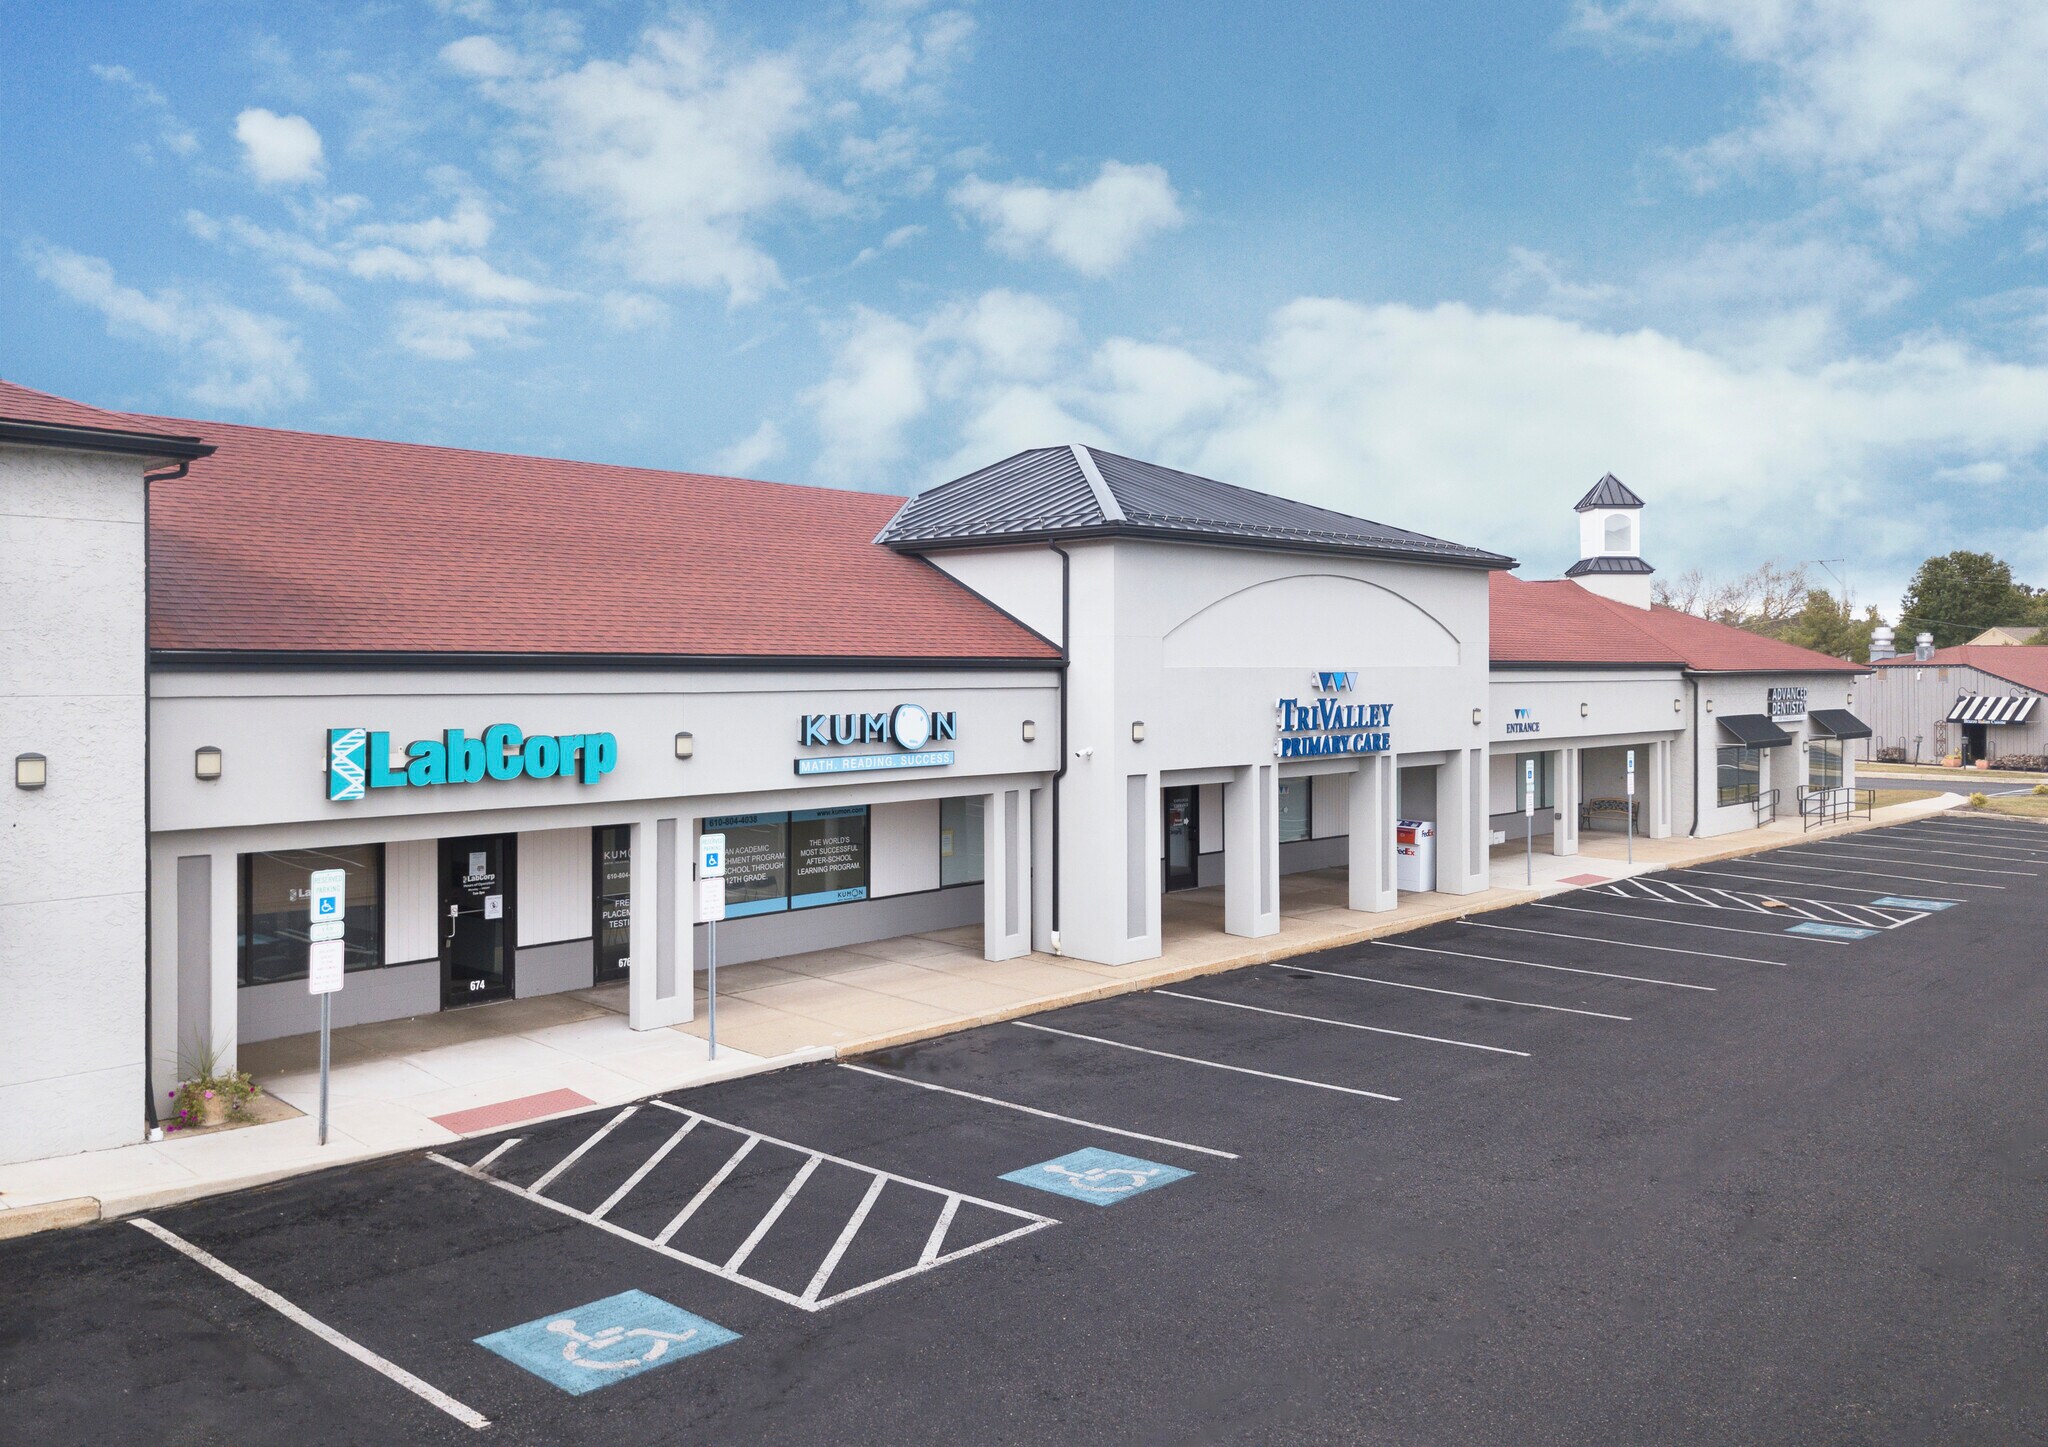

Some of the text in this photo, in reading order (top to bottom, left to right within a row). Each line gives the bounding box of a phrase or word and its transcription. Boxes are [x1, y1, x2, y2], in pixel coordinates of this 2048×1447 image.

[1772, 687, 1807, 700] ADVANCED
[1772, 701, 1806, 714] DENTISTRY
[801, 703, 957, 750] KUMON
[1506, 722, 1540, 733] ENTRANCE
[1278, 732, 1390, 757] PRIMARY CARE
[366, 723, 618, 787] LabCorp
[800, 753, 953, 773] MATH. READING. SUCCESS.
[816, 807, 864, 817] www.kumon.com
[709, 815, 758, 827] 610-804-4038
[1421, 829, 1434, 837] FedEx
[822, 836, 850, 845] WORLD'S
[603, 848, 630, 860] KUM
[725, 844, 769, 855] AN ACADEMIC
[800, 845, 858, 857] MOST SUCCESSFUL
[752, 852, 786, 862] PROGRAM.
[806, 854, 852, 865] AFTER-SCHOOL
[752, 862, 784, 872] THROUGH
[797, 862, 861, 876] LEARNING PROGRAM.
[314, 875, 343, 884] RESERVED
[467, 873, 496, 883] LabCorp
[725, 876, 742, 884] 12TH
[316, 884, 341, 893] PARKING
[837, 888, 864, 898] KUMON
[615, 899, 630, 908] FRE
[609, 919, 630, 928] TESTI
[470, 980, 485, 991] 674
